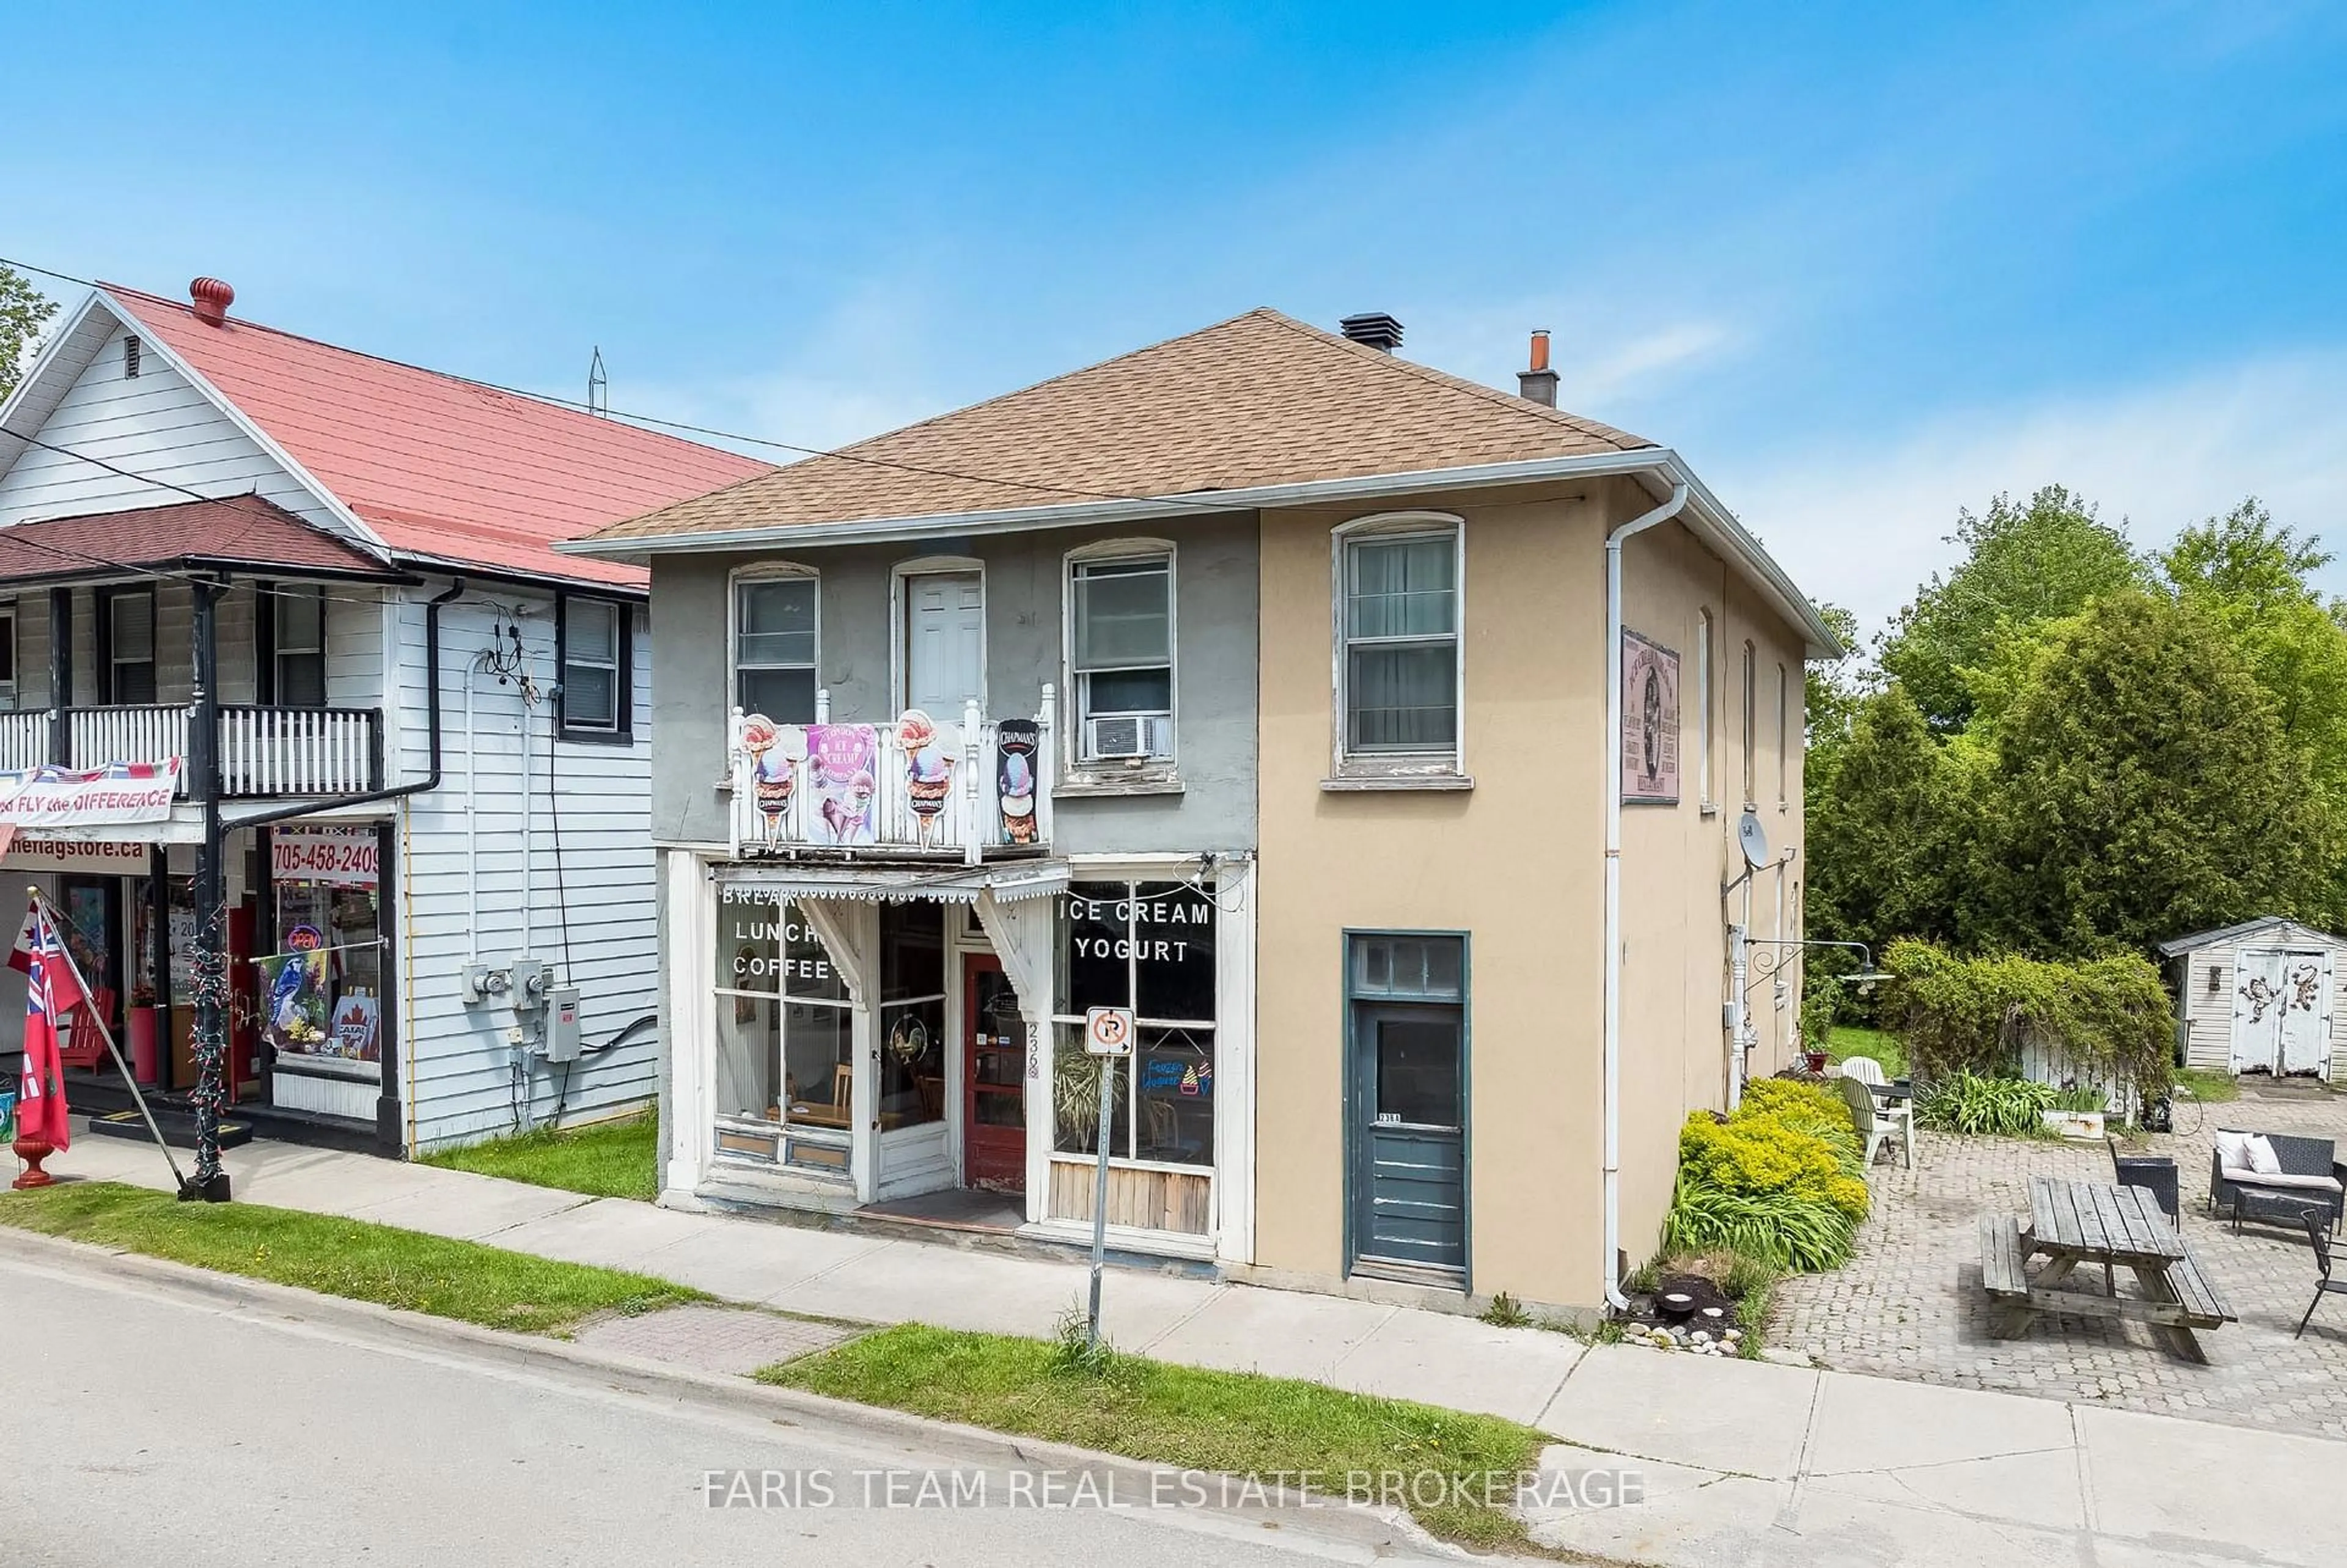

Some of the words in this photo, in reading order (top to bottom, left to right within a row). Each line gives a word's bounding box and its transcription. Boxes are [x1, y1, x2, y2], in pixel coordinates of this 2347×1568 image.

[18, 796, 46, 813] FLY
[47, 796, 70, 812] the
[74, 788, 170, 811] DIFFERENCE
[1060, 900, 1101, 920] ICE
[1116, 903, 1208, 925] CREAM
[293, 932, 317, 947] OPEN
[736, 922, 819, 942] LUNCH
[1075, 938, 1188, 962] YOGURT
[734, 957, 829, 978] COFFEE
